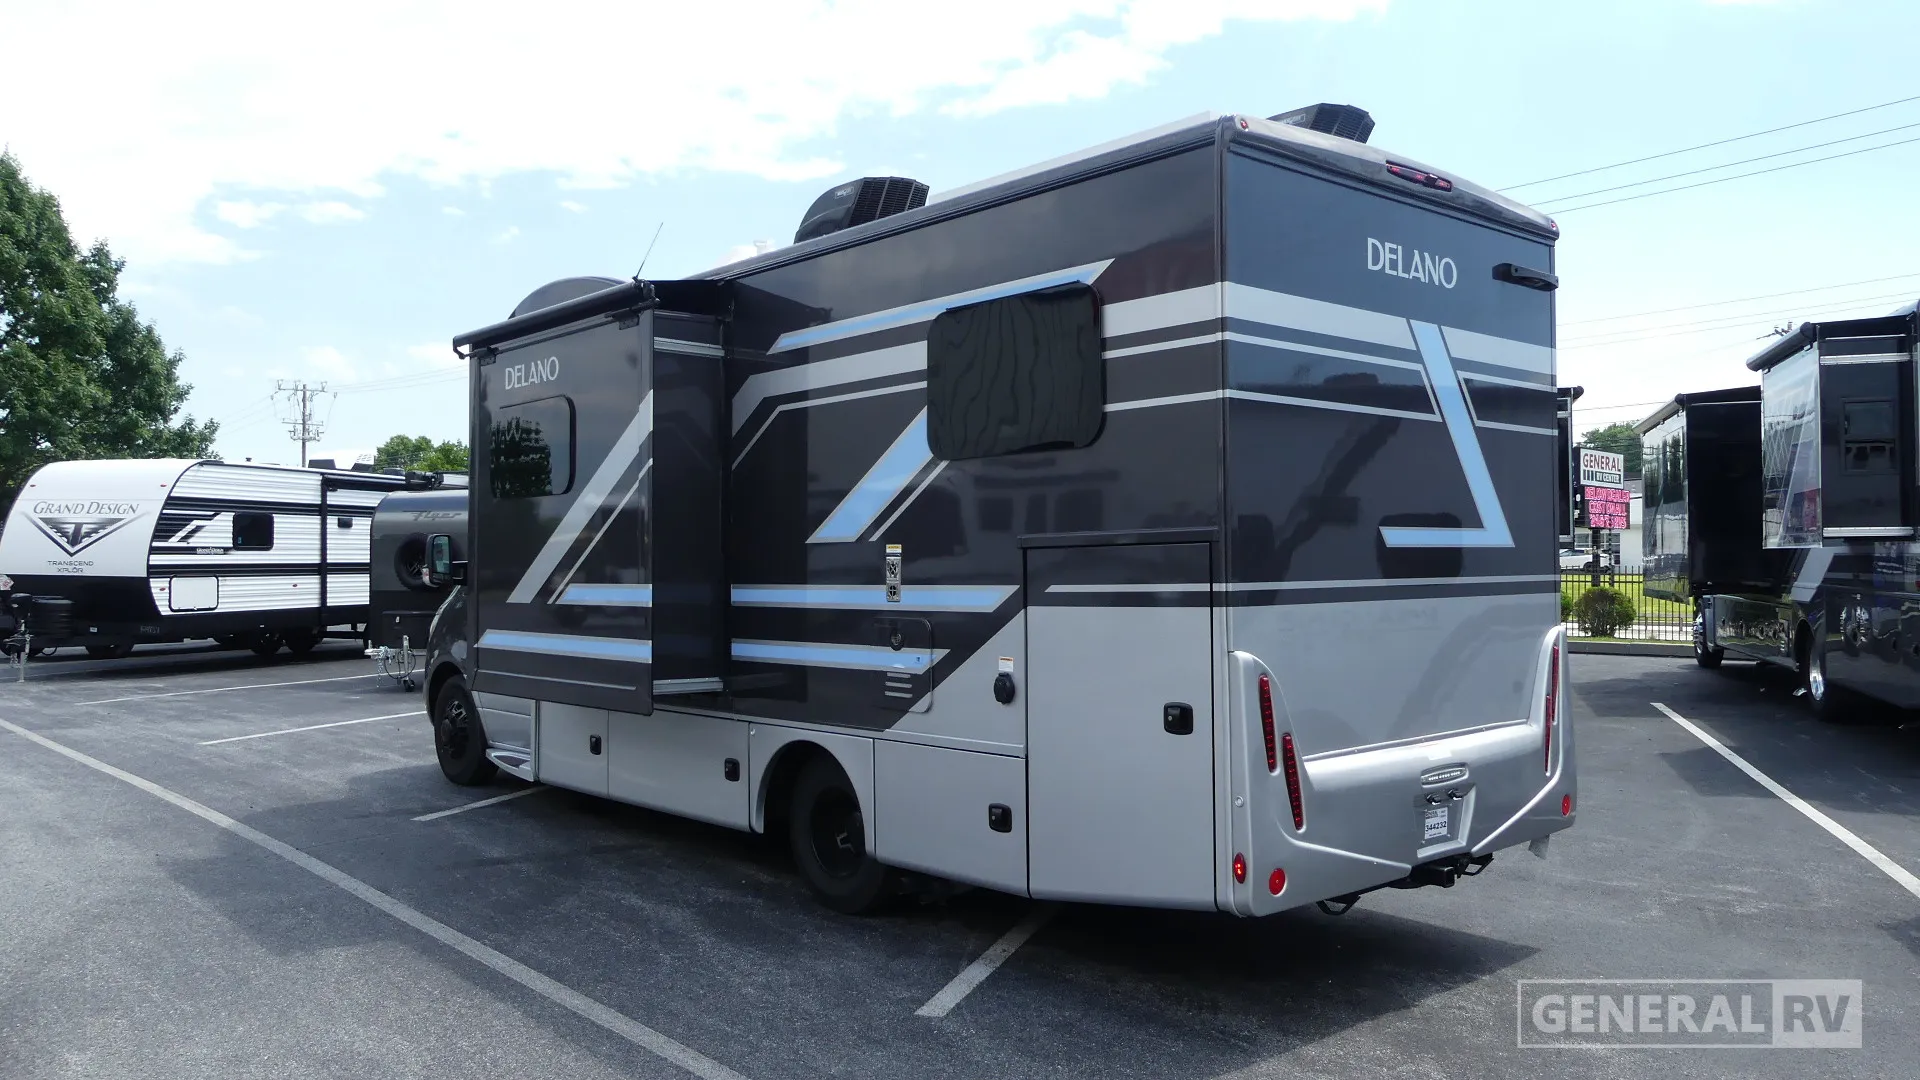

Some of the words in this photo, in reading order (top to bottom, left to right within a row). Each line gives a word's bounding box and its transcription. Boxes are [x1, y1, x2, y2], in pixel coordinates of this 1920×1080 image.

[1367, 237, 1458, 289] DELANO
[505, 356, 559, 390] DELANO
[1582, 453, 1622, 472] GENERAL
[1602, 473, 1620, 483] CENTER
[33, 501, 84, 514] GRAND
[86, 501, 139, 515] DESIGN
[1425, 820, 1447, 832] 344232
